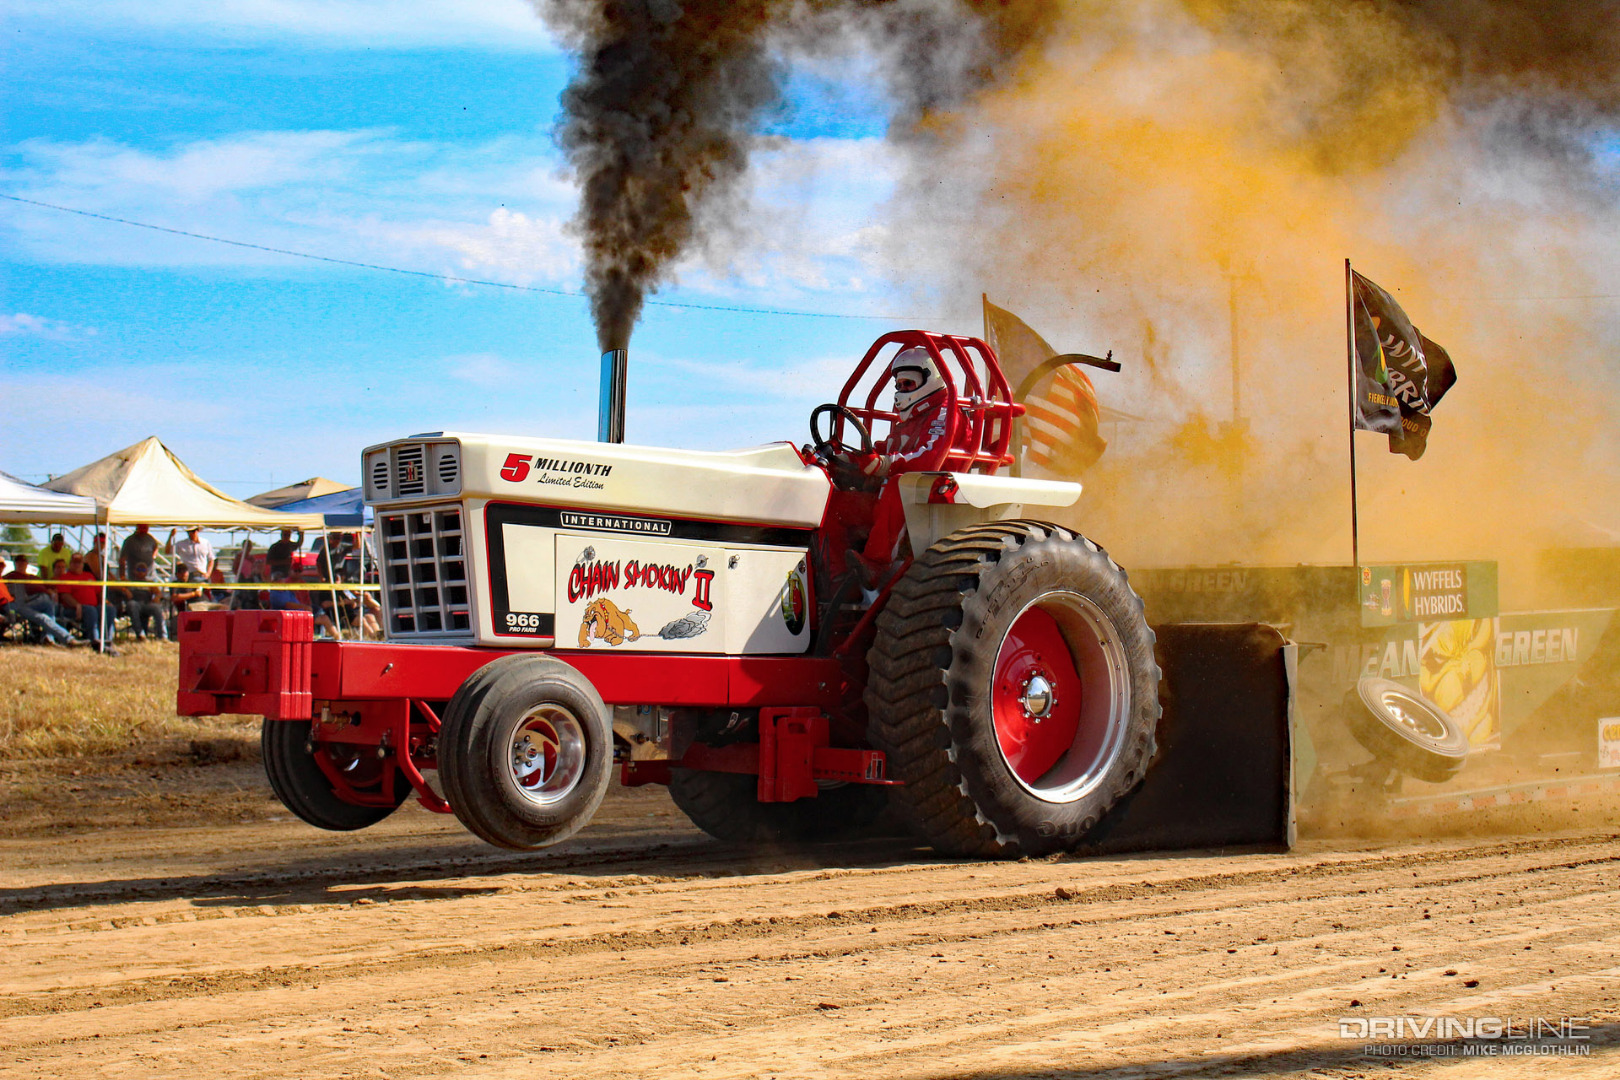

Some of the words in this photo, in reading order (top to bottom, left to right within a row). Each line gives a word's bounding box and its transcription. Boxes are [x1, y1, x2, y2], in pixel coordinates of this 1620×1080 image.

[500, 453, 533, 482] 5
[534, 457, 612, 477] MILLIONTH
[537, 473, 572, 486] Limited
[573, 477, 604, 490] Edition
[565, 515, 667, 532] INTERNATIONAL
[568, 560, 620, 603] CHAIN
[624, 560, 693, 595] SMOKIN'
[692, 569, 715, 611] II
[1413, 569, 1462, 590] WYFFELS
[506, 613, 540, 627] 966
[1495, 628, 1578, 667] GREEN
